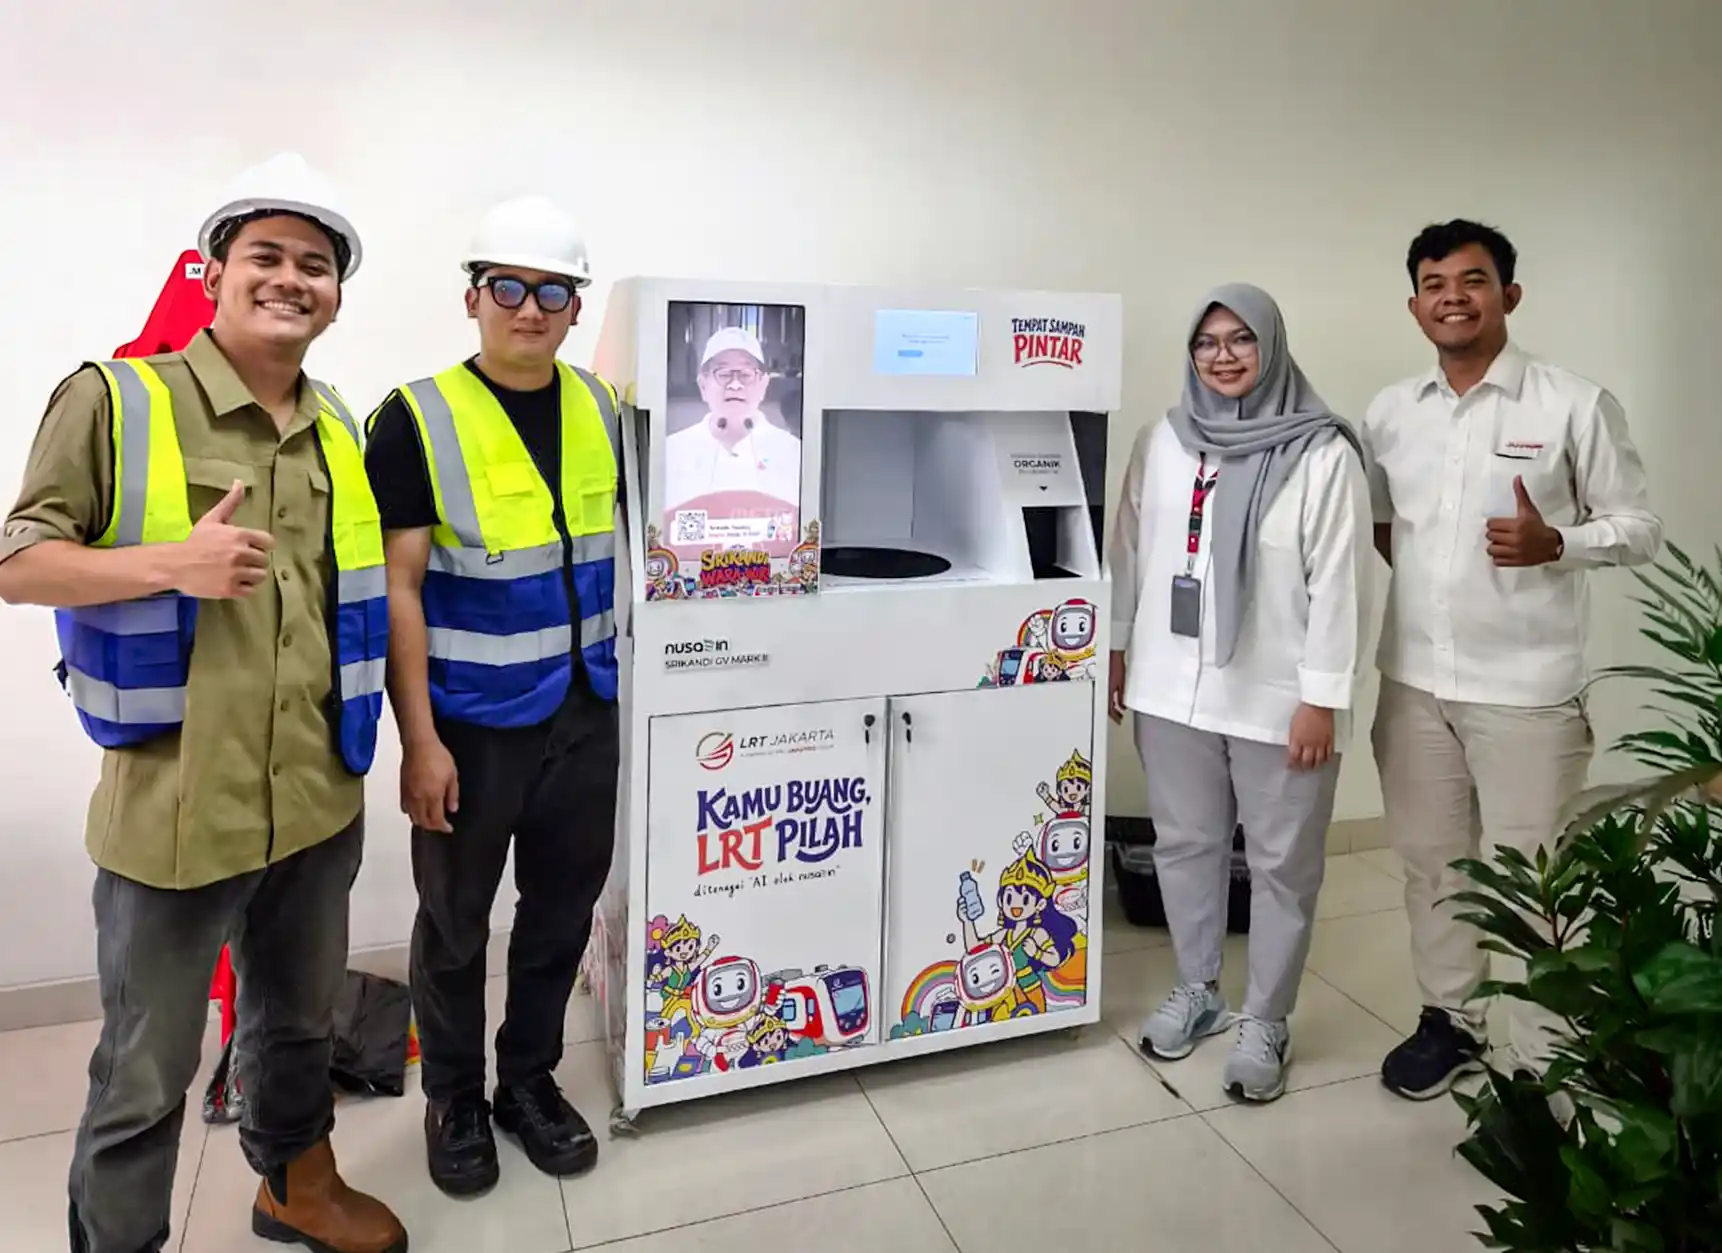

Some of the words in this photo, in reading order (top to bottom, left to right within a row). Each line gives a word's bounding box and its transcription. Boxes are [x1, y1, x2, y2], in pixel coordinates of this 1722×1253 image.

[1011, 318, 1048, 333] TEMPAT
[1048, 319, 1085, 337] SAMPAH
[1013, 334, 1083, 364] PINTAR
[1014, 460, 1060, 468] ORGANIK
[665, 657, 712, 669] SRIKANDI
[731, 654, 760, 664] MARK
[740, 735, 768, 748] LRT
[769, 729, 834, 746] JAKARTA
[697, 785, 782, 831] KAMU
[786, 777, 871, 814] BUANG,
[697, 815, 772, 876] LRT
[775, 809, 863, 862] PILAH
[774, 871, 794, 885] oleh
